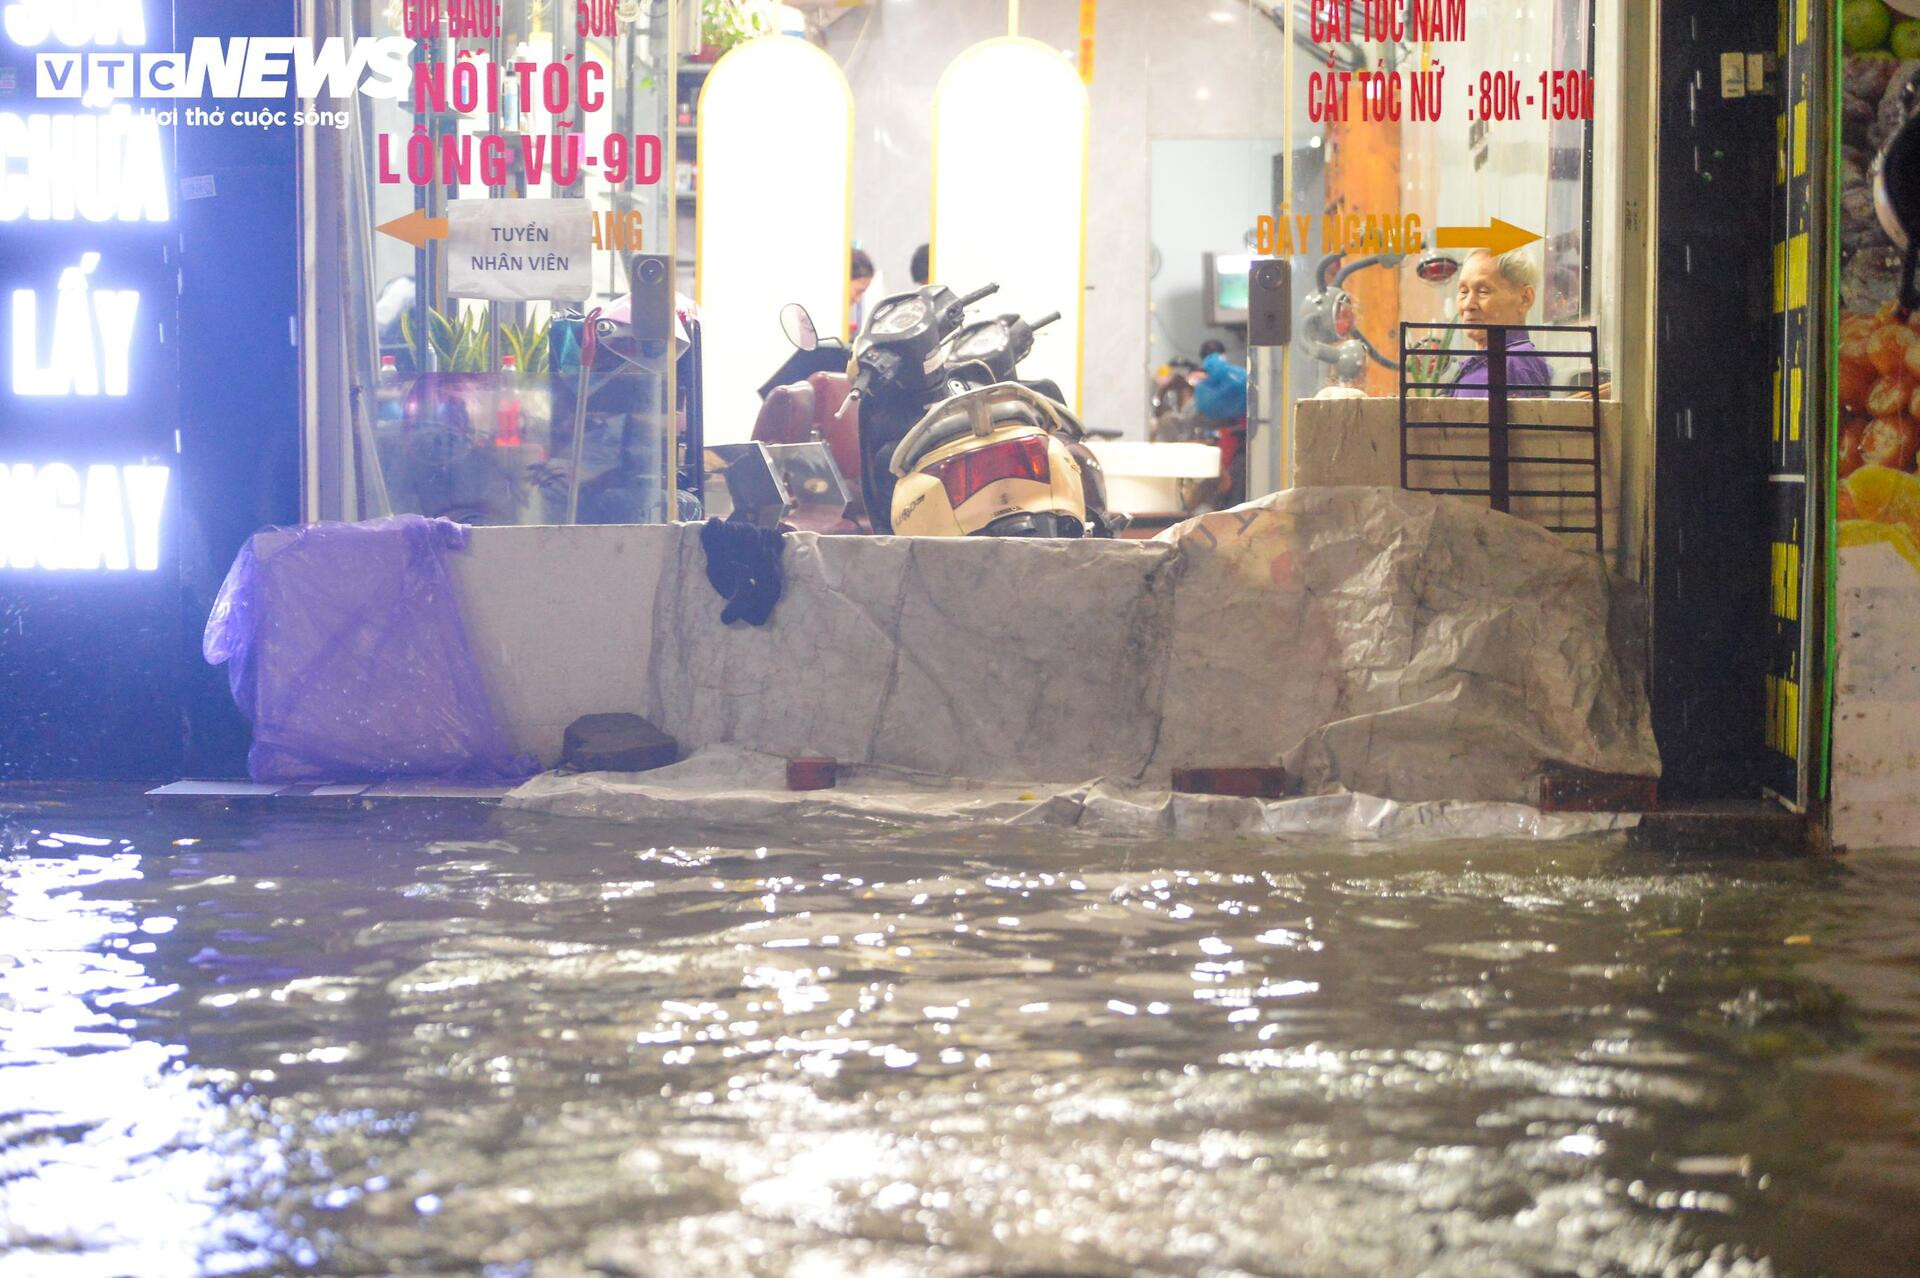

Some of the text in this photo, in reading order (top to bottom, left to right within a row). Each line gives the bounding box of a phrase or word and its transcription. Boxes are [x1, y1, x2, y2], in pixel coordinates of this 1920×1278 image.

[1413, 0, 1466, 43] NAM
[415, 48, 604, 113] NỐI TÓC
[1308, 49, 1352, 123] CẮT
[1358, 58, 1402, 123] TÓC
[1410, 58, 1445, 122] NỮ
[378, 124, 507, 186] LÔNG
[491, 221, 549, 242] TUYỂN
[1321, 212, 1422, 256] NGANG
[471, 252, 569, 271] NHÂN VIÊN
[12, 252, 140, 396] LẤY
